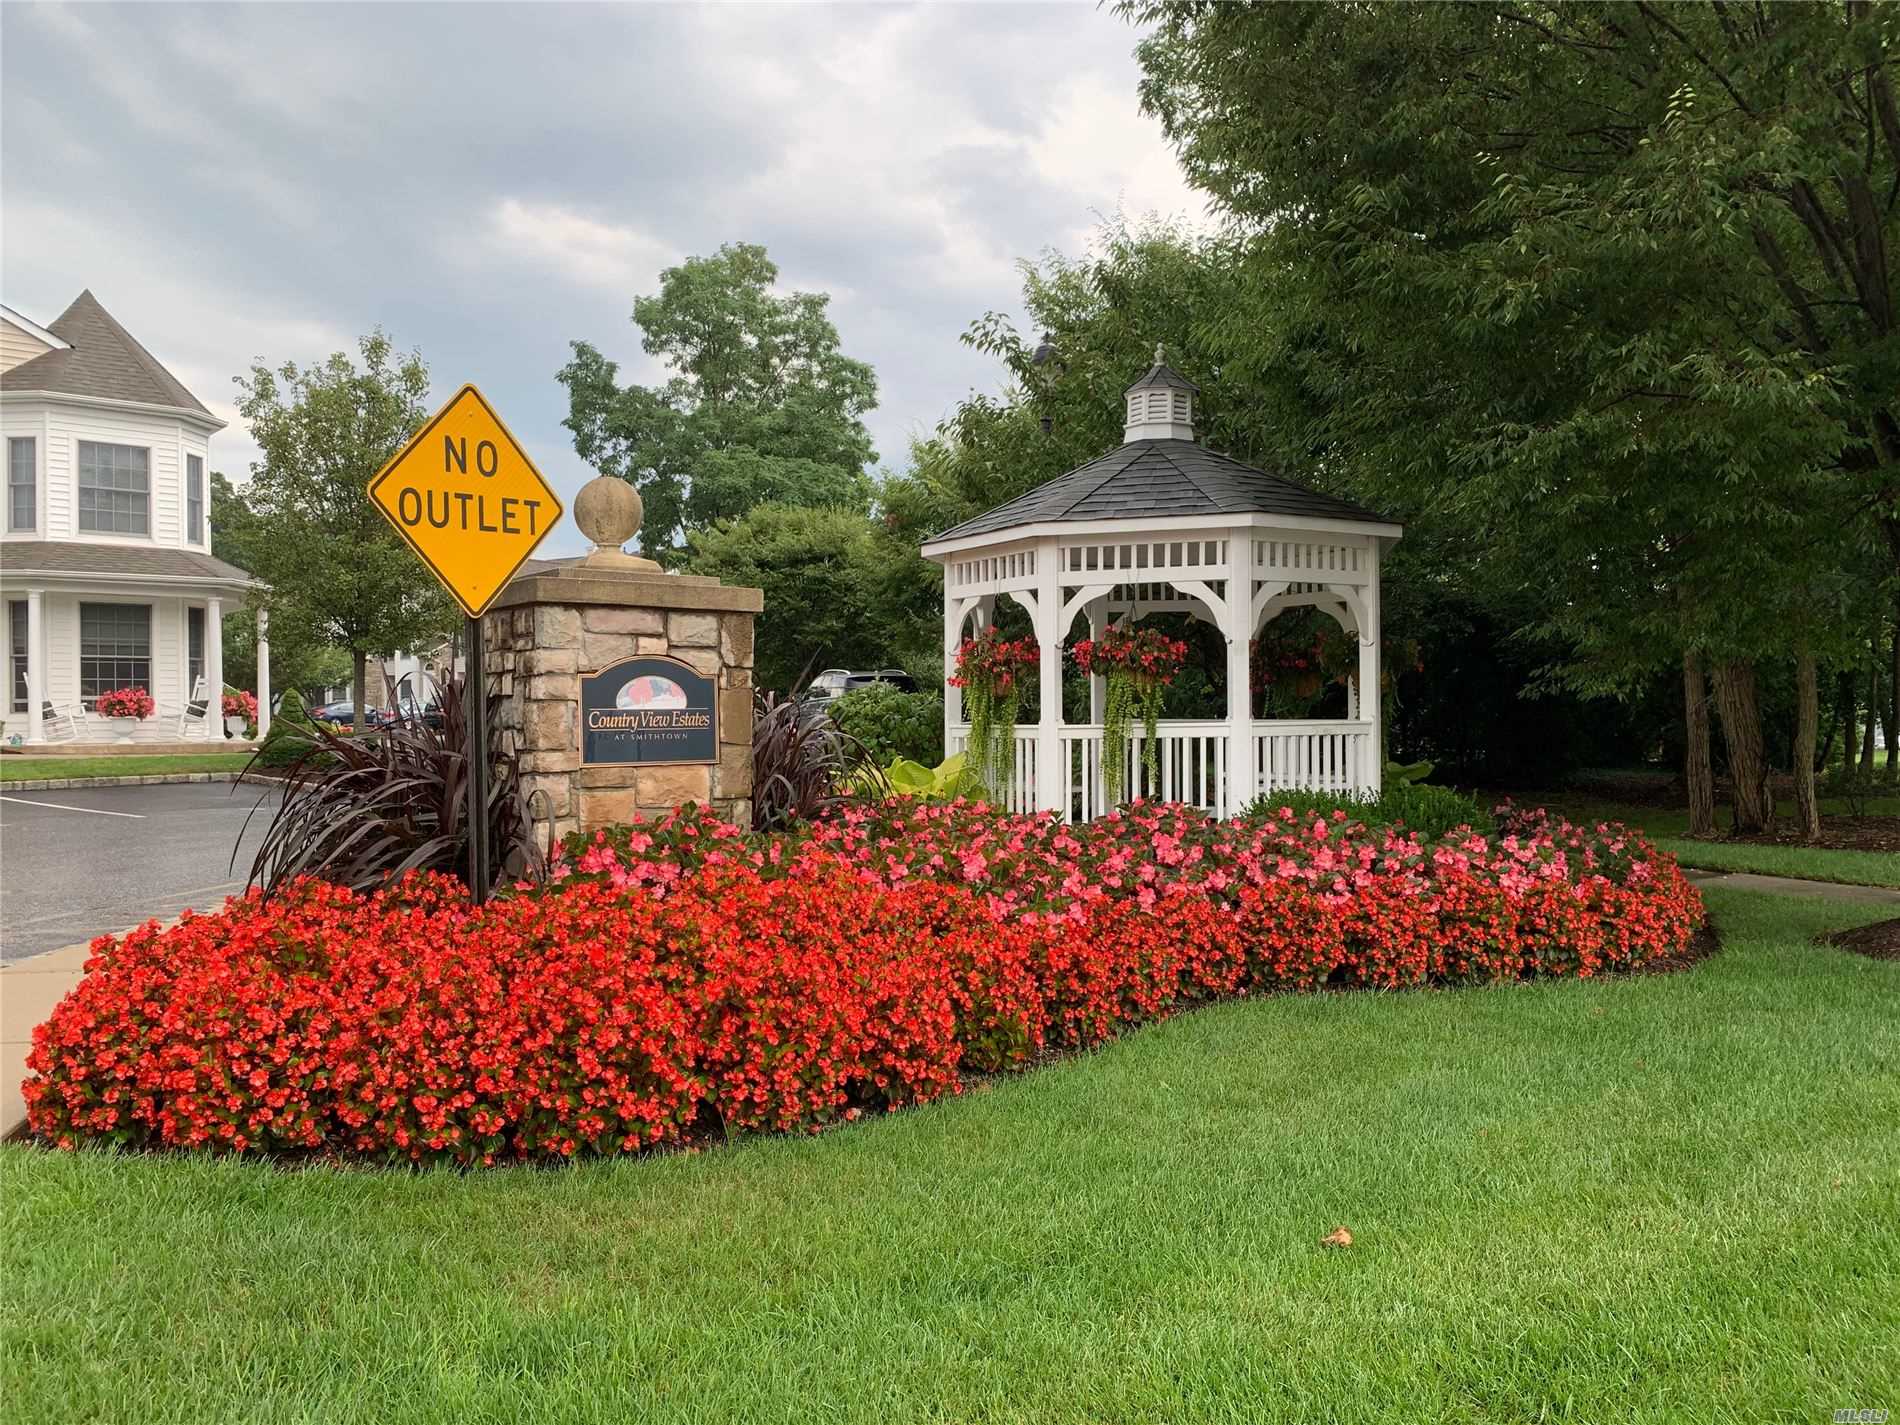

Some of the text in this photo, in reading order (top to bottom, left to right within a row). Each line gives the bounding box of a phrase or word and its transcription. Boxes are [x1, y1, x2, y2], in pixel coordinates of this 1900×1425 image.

[445, 435, 498, 477] NO
[398, 487, 541, 536] OUTLET
[589, 711, 710, 732] Country View Estates
[631, 733, 688, 741] SMITHTOWN
